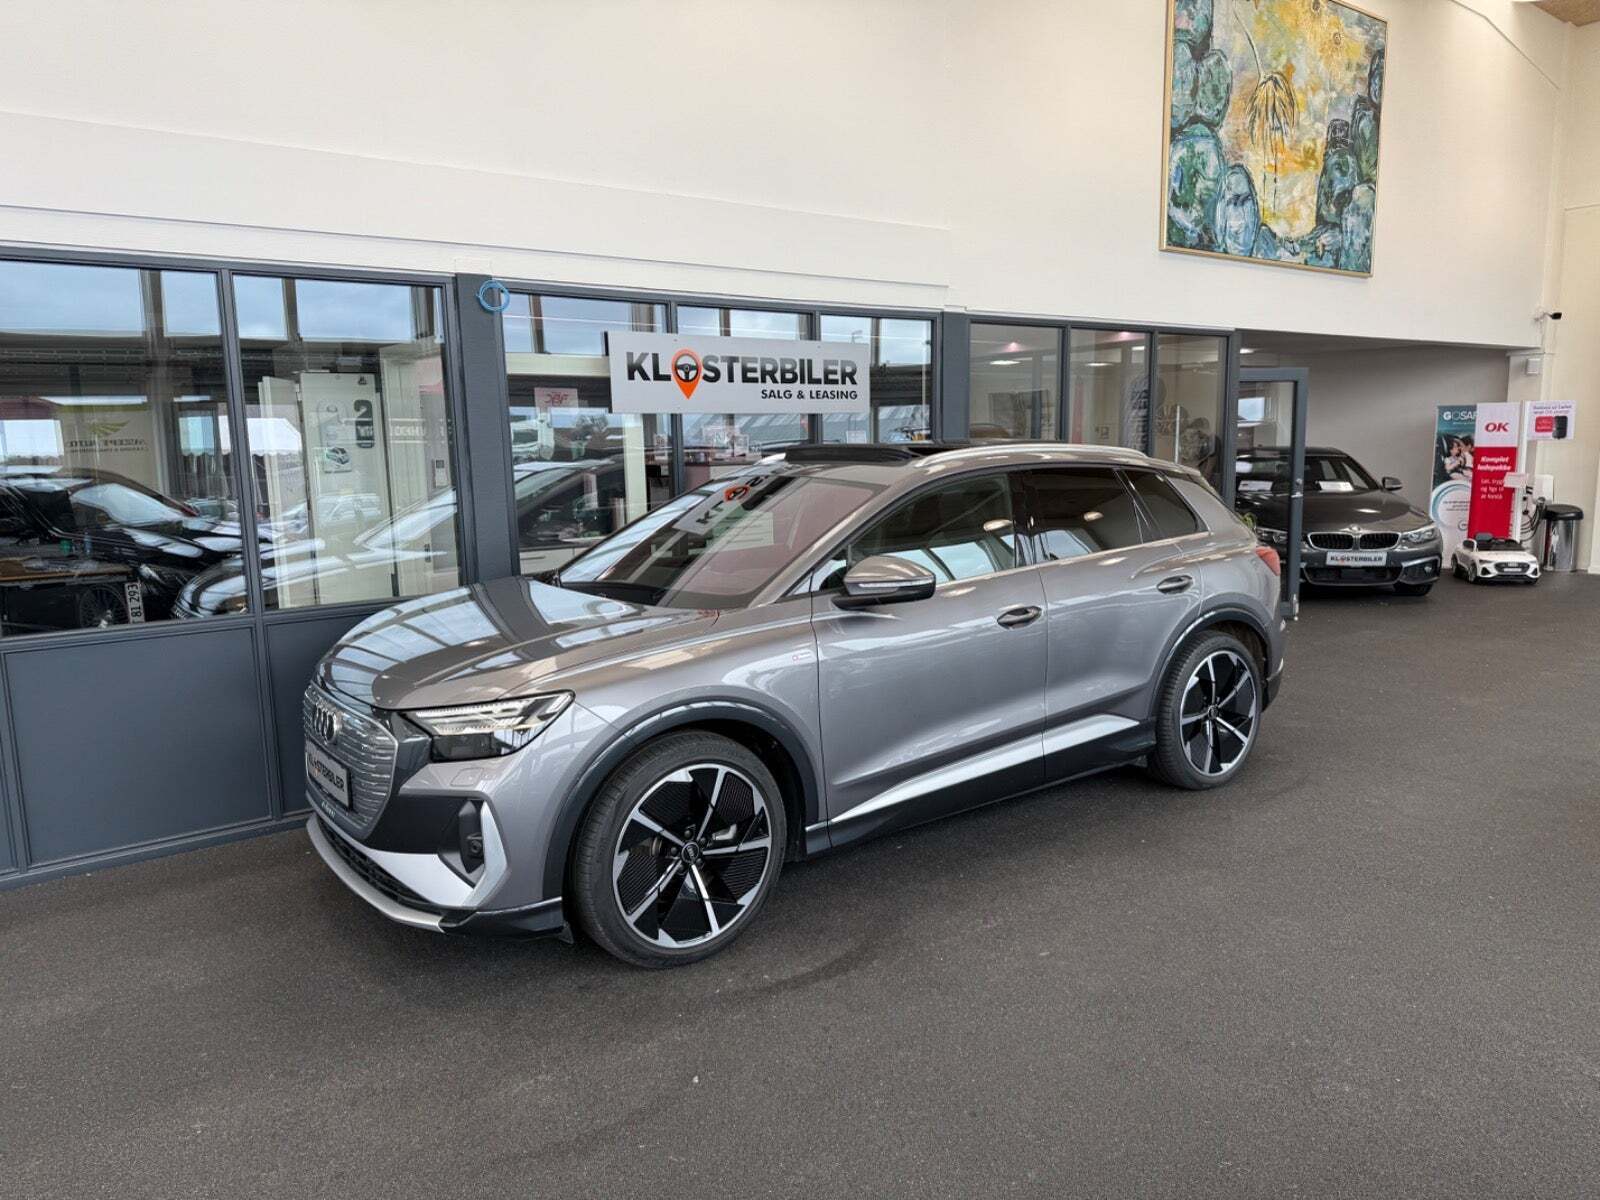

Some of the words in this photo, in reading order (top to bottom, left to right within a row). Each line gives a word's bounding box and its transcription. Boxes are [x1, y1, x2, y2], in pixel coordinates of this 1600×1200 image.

[761, 389, 793, 400] SALG
[797, 389, 805, 400] &
[809, 389, 858, 400] LEASING
[1485, 422, 1510, 433] OK
[127, 584, 140, 603] 293
